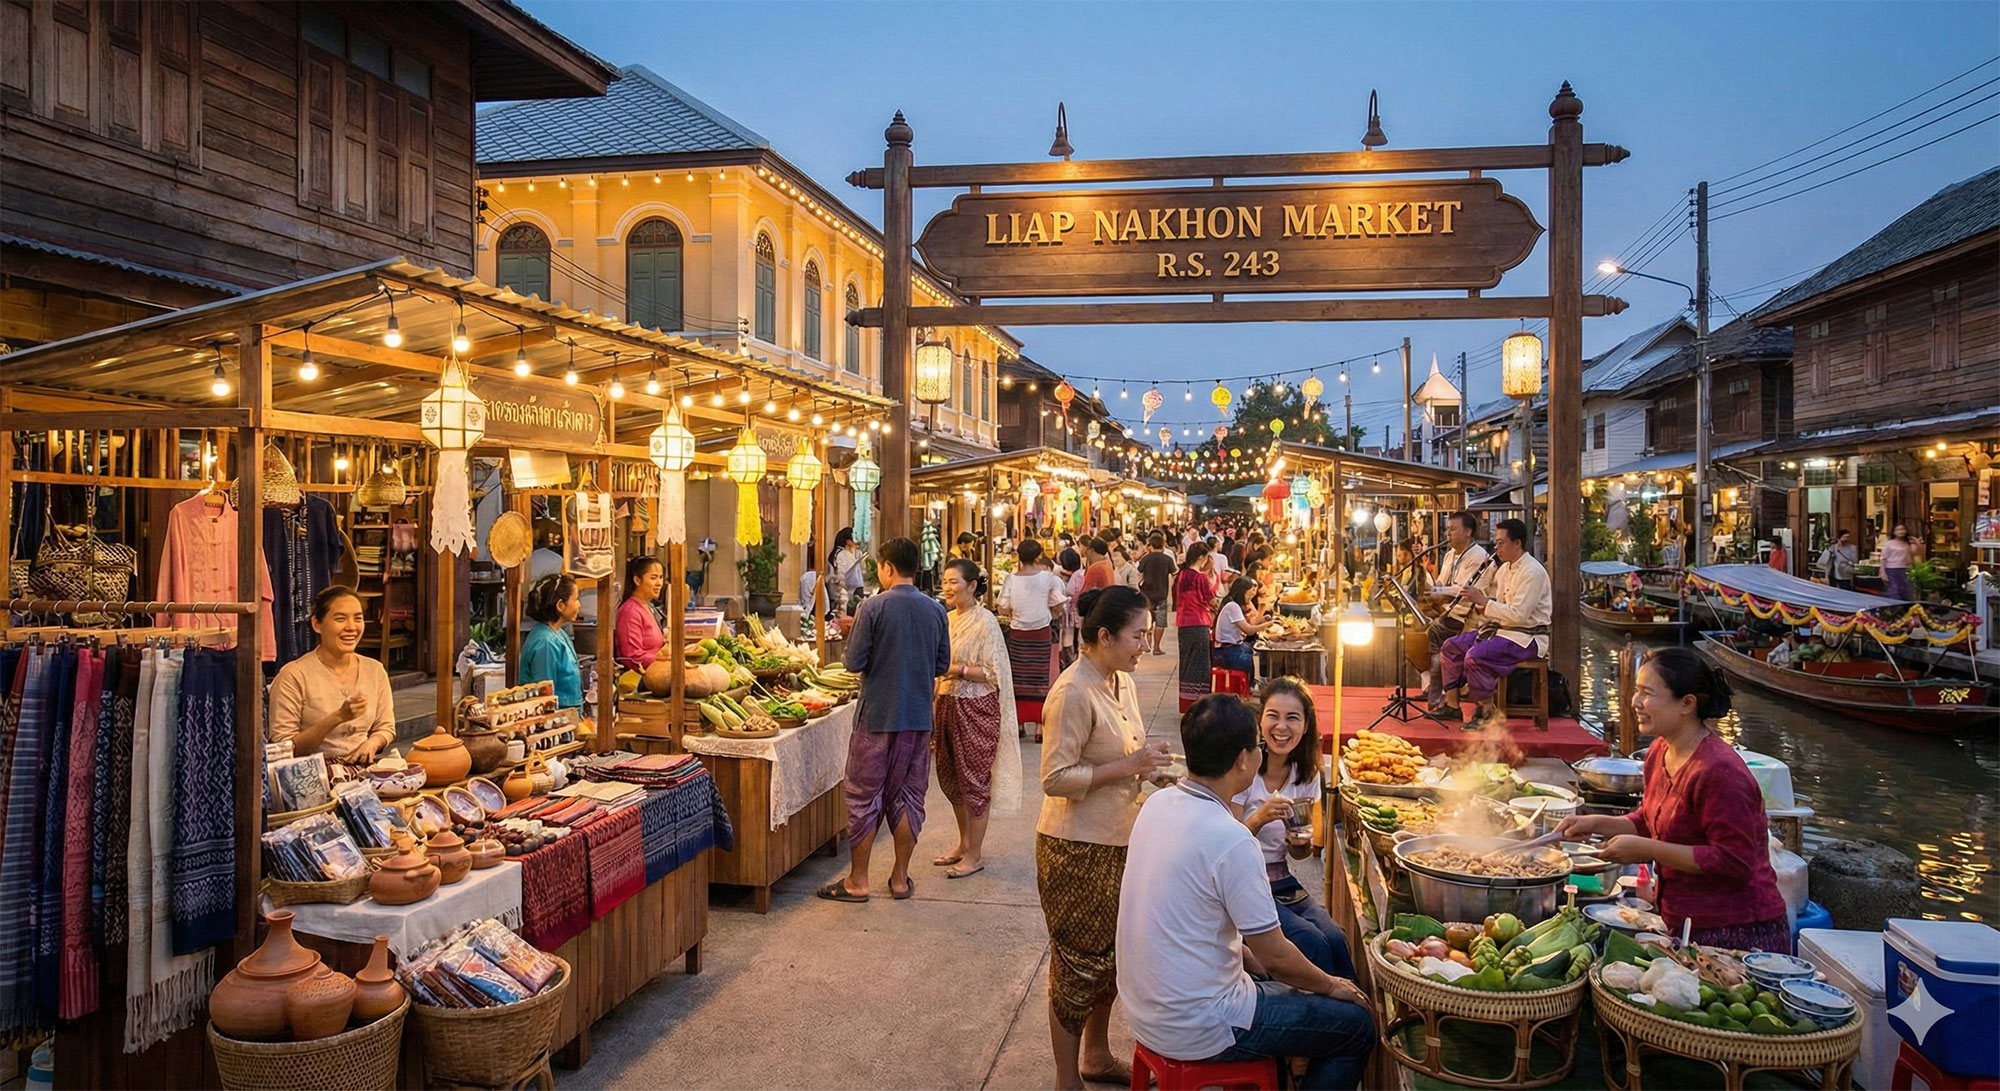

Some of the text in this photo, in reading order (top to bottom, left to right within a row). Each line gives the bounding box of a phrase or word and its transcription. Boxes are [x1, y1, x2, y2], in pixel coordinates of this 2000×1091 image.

[985, 201, 1462, 245] LIAP NAKHON MARKET
[1156, 250, 1281, 278] R.S. 243
